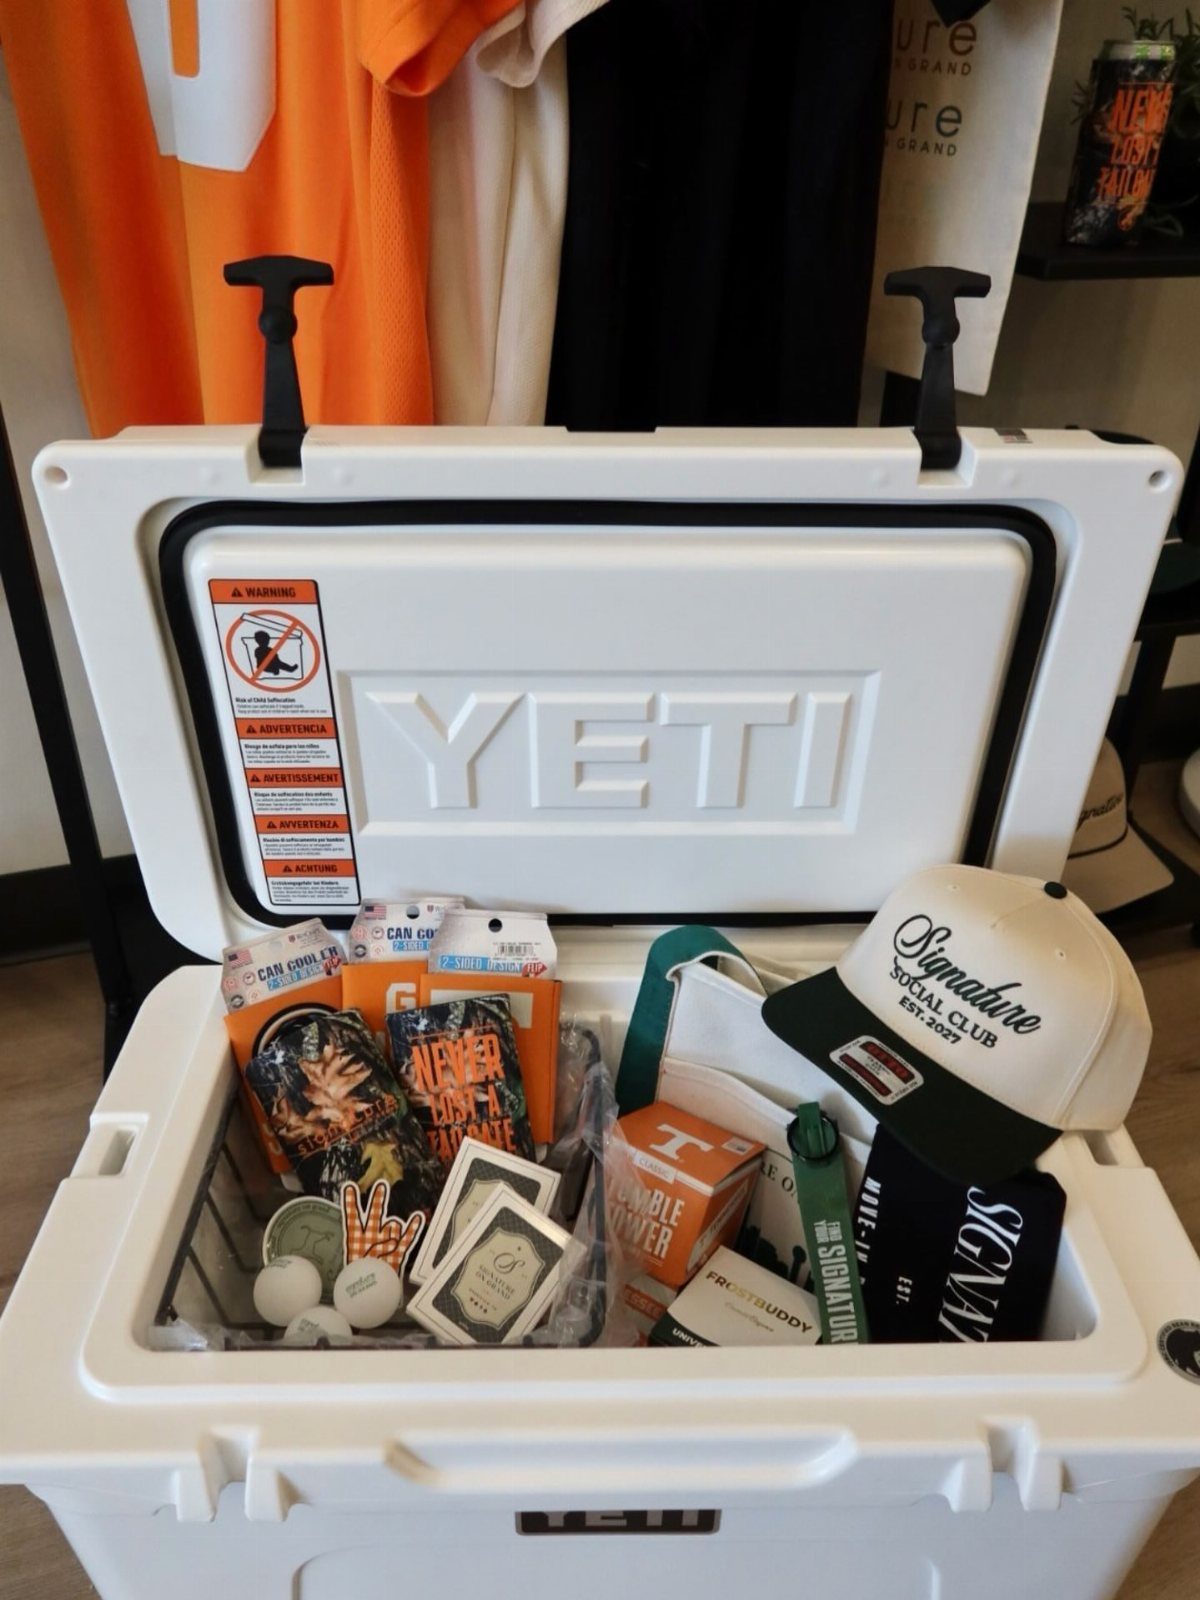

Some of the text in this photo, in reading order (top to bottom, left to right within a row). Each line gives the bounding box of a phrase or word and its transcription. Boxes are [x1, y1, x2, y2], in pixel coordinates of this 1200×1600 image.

[908, 59, 972, 76] GRAND
[896, 138, 957, 157] GRAND
[245, 587, 297, 598] WARNING
[259, 724, 327, 735] ADVERTENCIA
[365, 692, 852, 809] YETI
[263, 773, 339, 783] AVERTISSEMENT
[279, 820, 339, 829] AVVERTENZA
[295, 864, 338, 873] ACHTUNG
[387, 927, 412, 940] CAN
[257, 962, 284, 982] CAN
[440, 955, 483, 971] 2-SIDED
[487, 957, 521, 972] DESIGN
[527, 962, 543, 972] FLIP
[893, 914, 1042, 1035] Signature
[890, 965, 998, 1048] SOCIAL CLUB
[899, 995, 962, 1044] EST. 2027
[411, 1034, 505, 1092] NEVER
[429, 1083, 501, 1126] LOST A
[855, 1176, 882, 1264] MOVE-IN
[706, 1271, 813, 1334] FROSTBUDDY
[817, 1244, 859, 1344] SIGNATUR
[672, 1327, 702, 1347] UNIV
